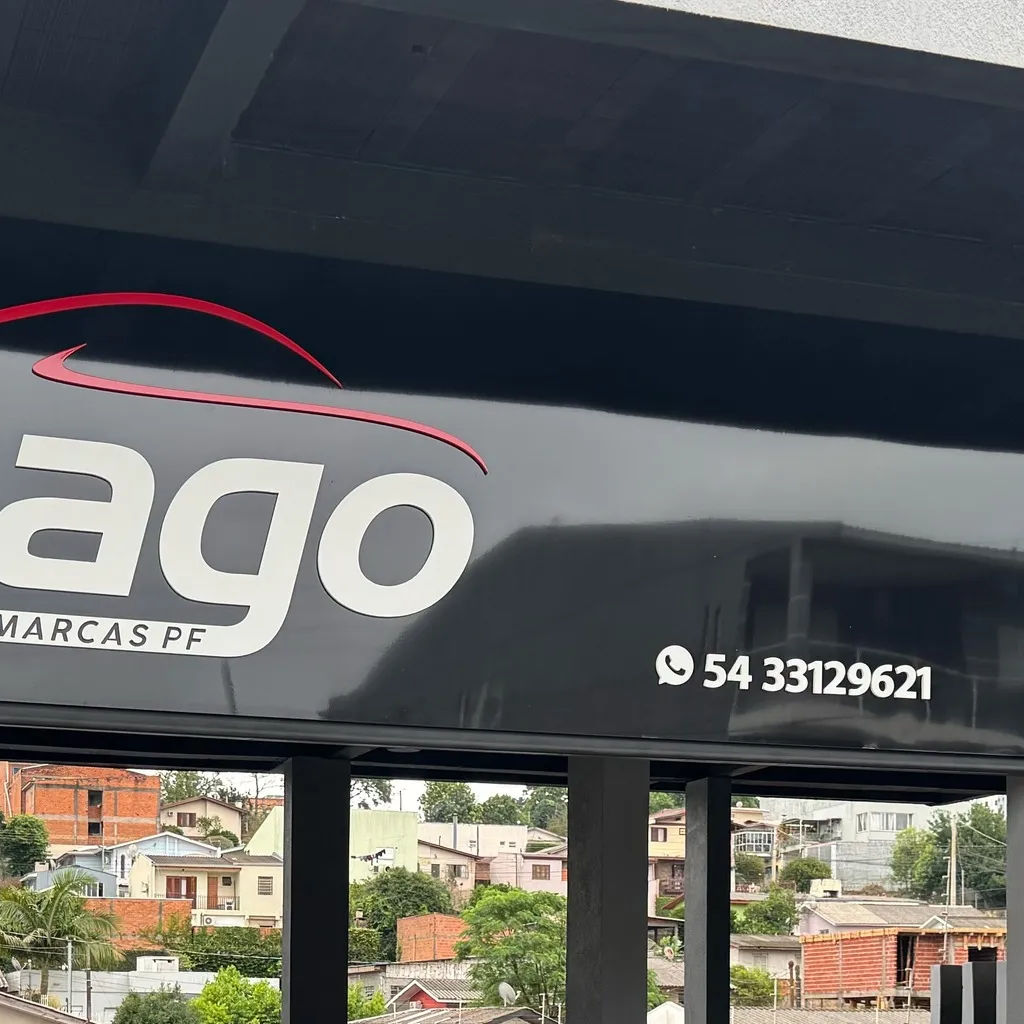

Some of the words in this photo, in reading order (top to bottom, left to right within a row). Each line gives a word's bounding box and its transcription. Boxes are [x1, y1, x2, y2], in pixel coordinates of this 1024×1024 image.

[161, 626, 207, 651] PF
[703, 653, 753, 690] 54
[761, 656, 932, 700] 33129621
